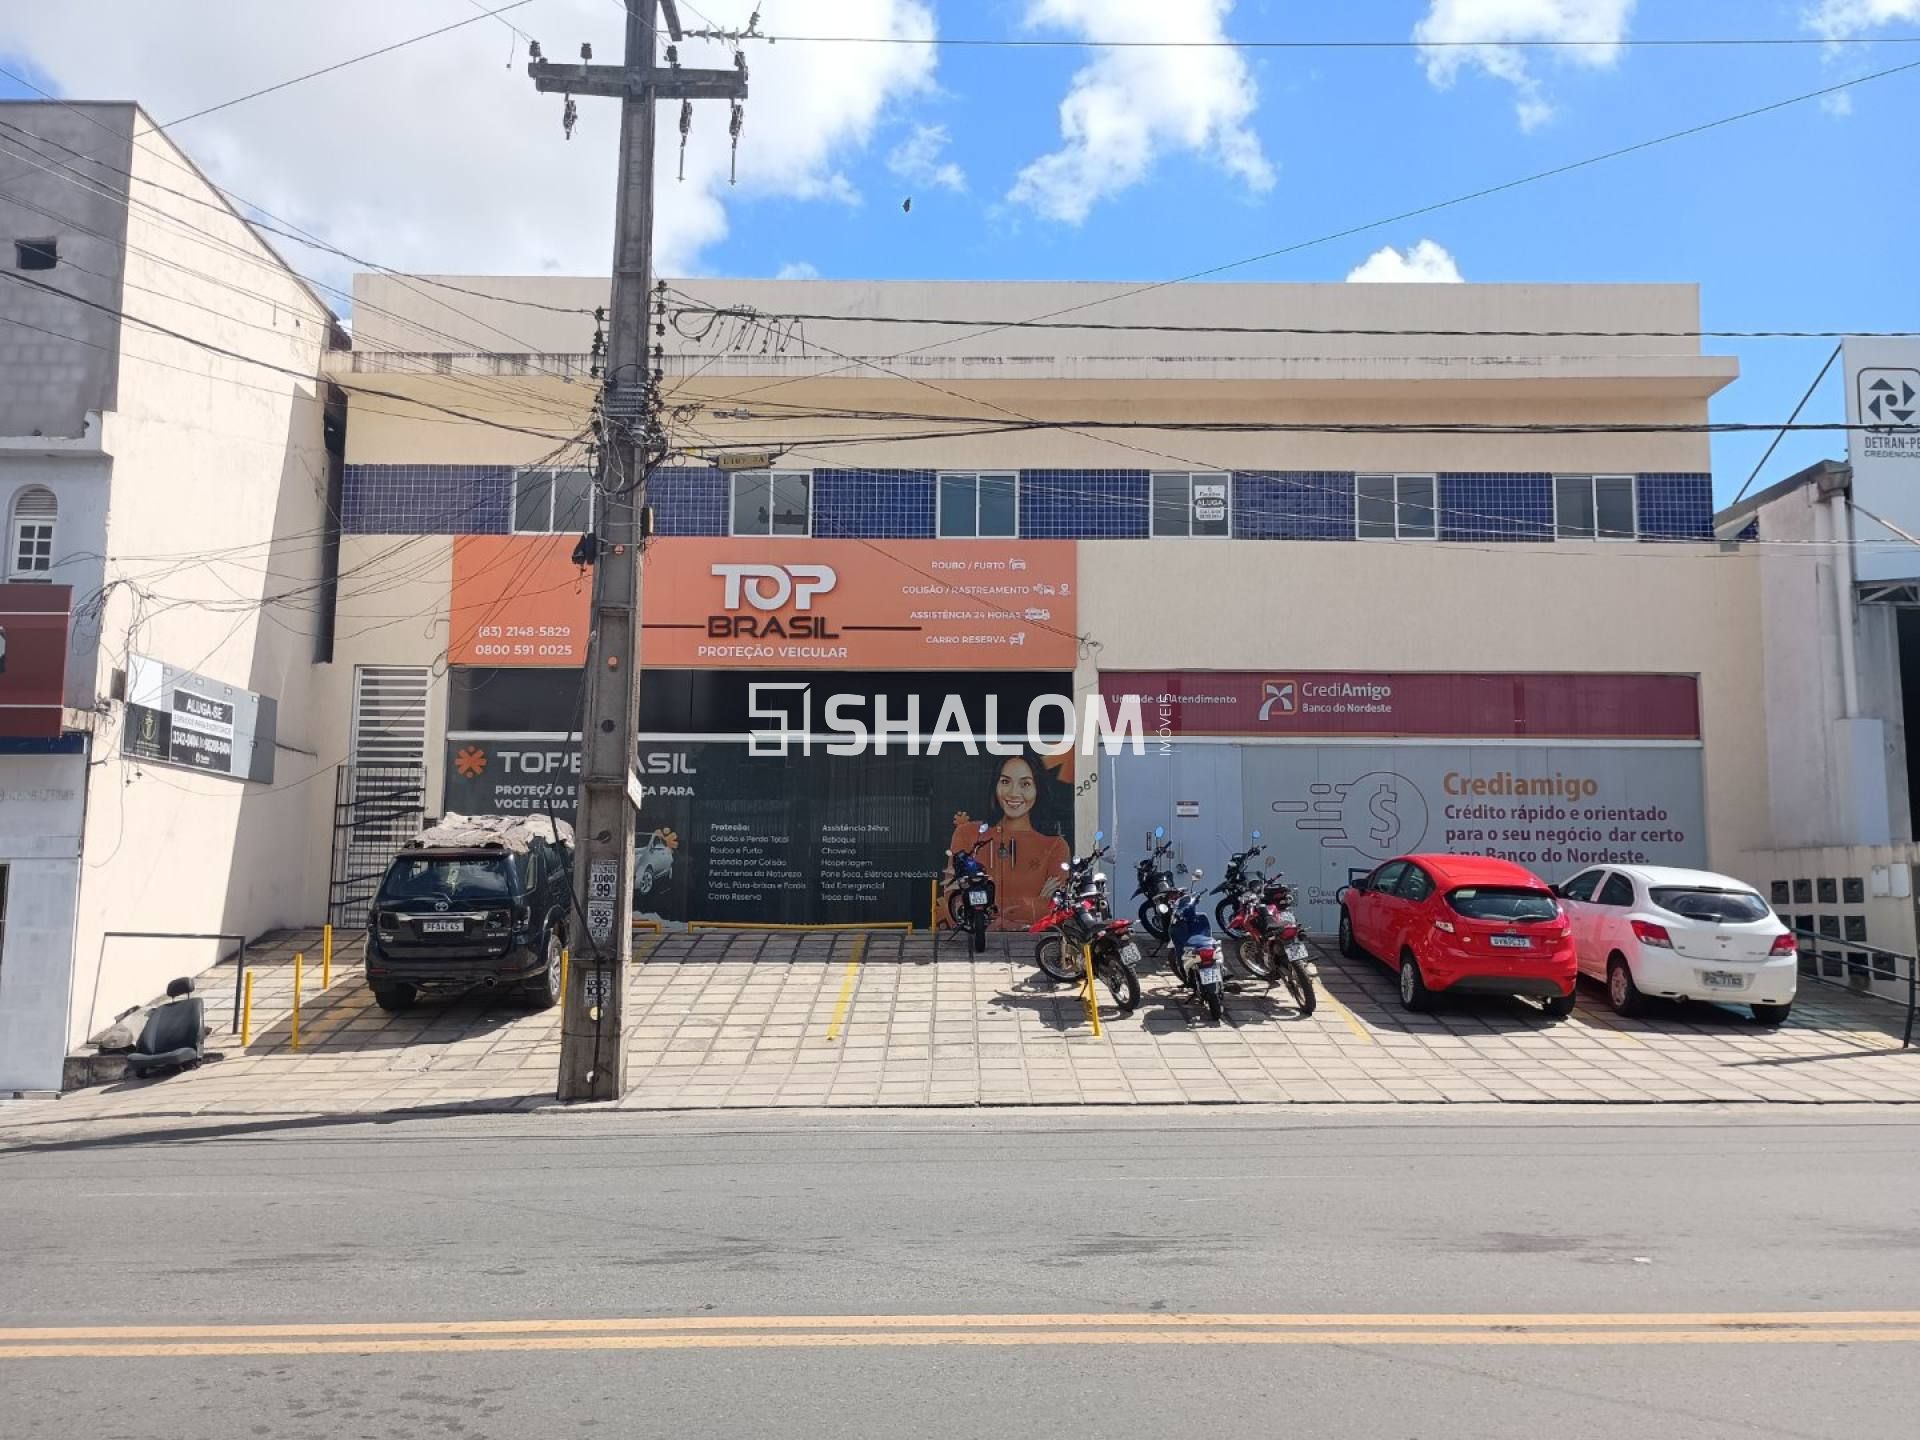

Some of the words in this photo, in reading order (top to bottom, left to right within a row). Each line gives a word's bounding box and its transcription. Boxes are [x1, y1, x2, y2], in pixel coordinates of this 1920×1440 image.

[931, 561, 966, 570] ROUBO
[974, 561, 1006, 570] FURTO
[711, 563, 838, 611] TOP
[902, 583, 944, 594] COLISÃO
[951, 586, 1030, 594] RASTREAMENTO
[910, 609, 972, 620] ASSISTÊNCIA
[972, 611, 985, 620] 24
[988, 611, 1021, 620] HORAS
[478, 626, 502, 638] (83)
[506, 626, 571, 638] 2148-5829
[707, 615, 840, 640] BRASIL
[925, 636, 960, 644] CARRO
[962, 636, 1006, 645] RESERVA
[475, 644, 510, 656] 0800
[514, 644, 535, 656] 591
[539, 644, 573, 656] 0025
[698, 644, 775, 660] PROTEÇÃO
[779, 647, 848, 659] VEICULAR
[1302, 682, 1392, 700] CrediAmigo
[1171, 694, 1237, 704] Atendimento
[1302, 703, 1332, 713] Banco
[1333, 703, 1346, 713] do
[1347, 703, 1392, 713] Nordeste
[495, 784, 564, 798] PROTEÇÃO
[660, 786, 695, 796] PARA
[1076, 773, 1098, 797] 280
[1443, 771, 1598, 801] Crediamigo
[495, 797, 529, 809] VOCÊ
[532, 800, 540, 809] E
[1444, 804, 1506, 821] Crédito
[1510, 804, 1566, 825] rápido
[1570, 809, 1580, 821] e
[1583, 805, 1668, 822] orientado
[1445, 829, 1485, 844] para
[1488, 830, 1498, 841] o
[1502, 829, 1531, 842] seu
[1535, 826, 1603, 846] negócio
[1608, 826, 1638, 843] dar
[1641, 828, 1685, 843] certo
[1485, 847, 1537, 863] Banco
[1541, 847, 1563, 863] do
[1567, 848, 1651, 865] Nordeste.
